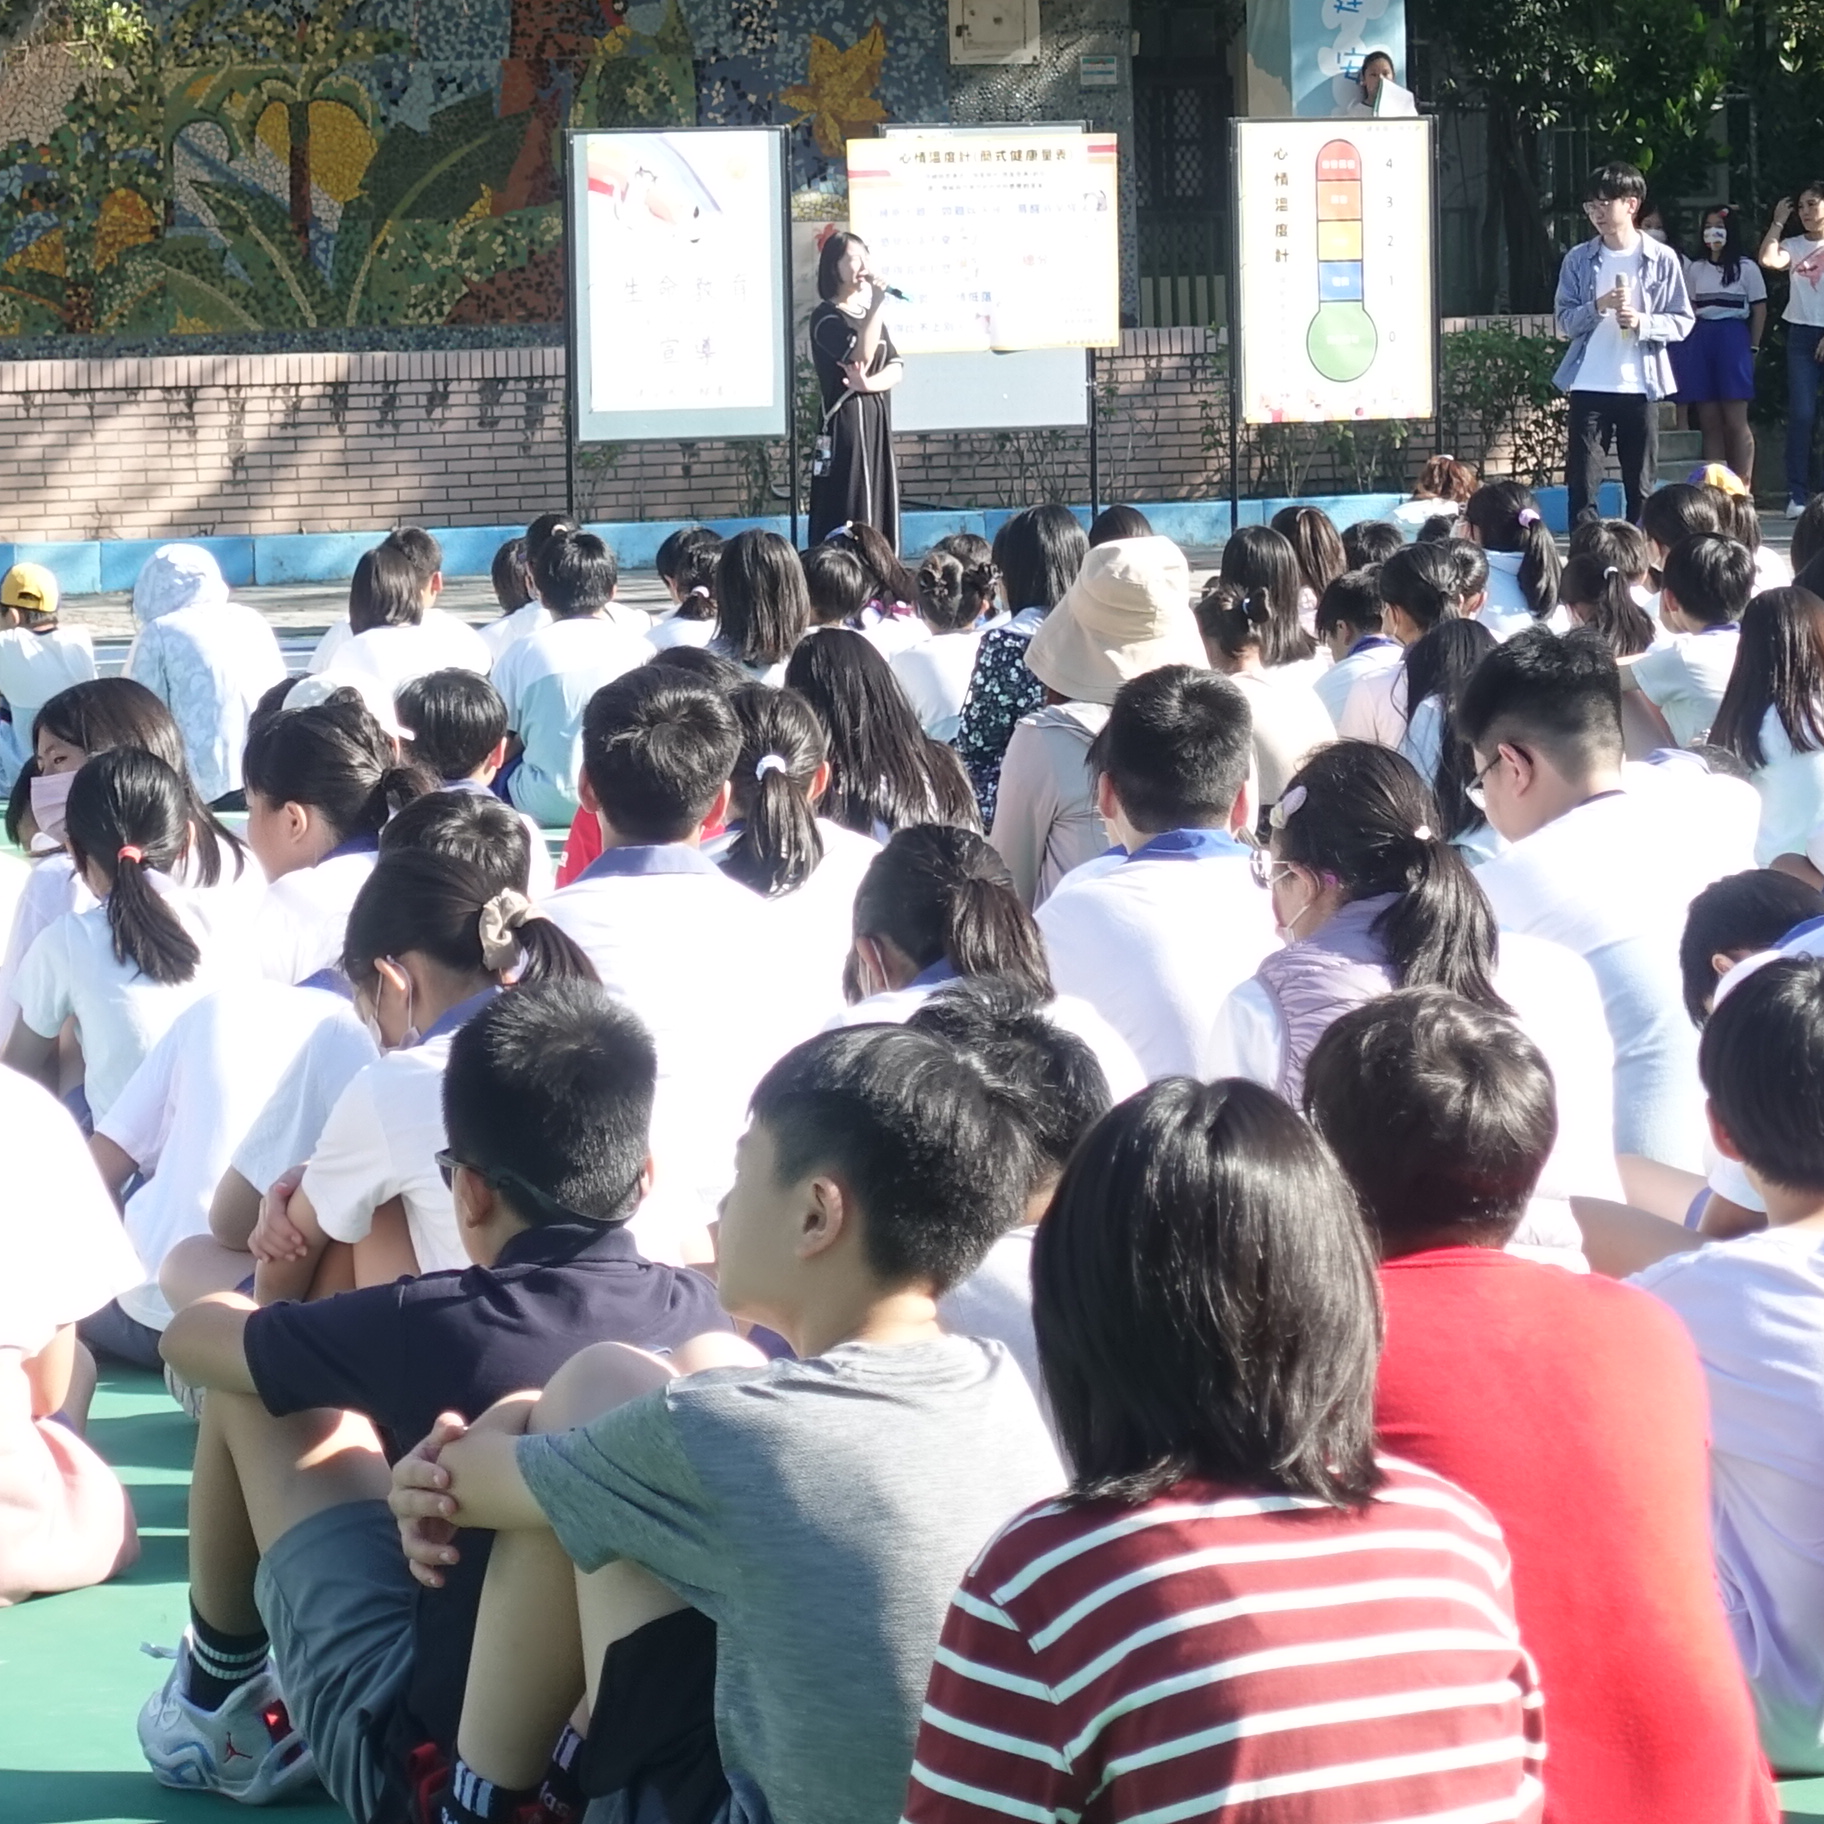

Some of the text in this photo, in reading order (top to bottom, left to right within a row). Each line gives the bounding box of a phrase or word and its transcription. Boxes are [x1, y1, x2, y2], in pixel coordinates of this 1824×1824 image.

[1385, 158, 1394, 169] 4
[1273, 147, 1290, 263] 心情溫度計
[1385, 196, 1394, 208] 3
[1387, 235, 1395, 247] 2
[624, 273, 747, 303] 生命教育
[1388, 330, 1396, 342] 0
[659, 336, 717, 366] 宣導
